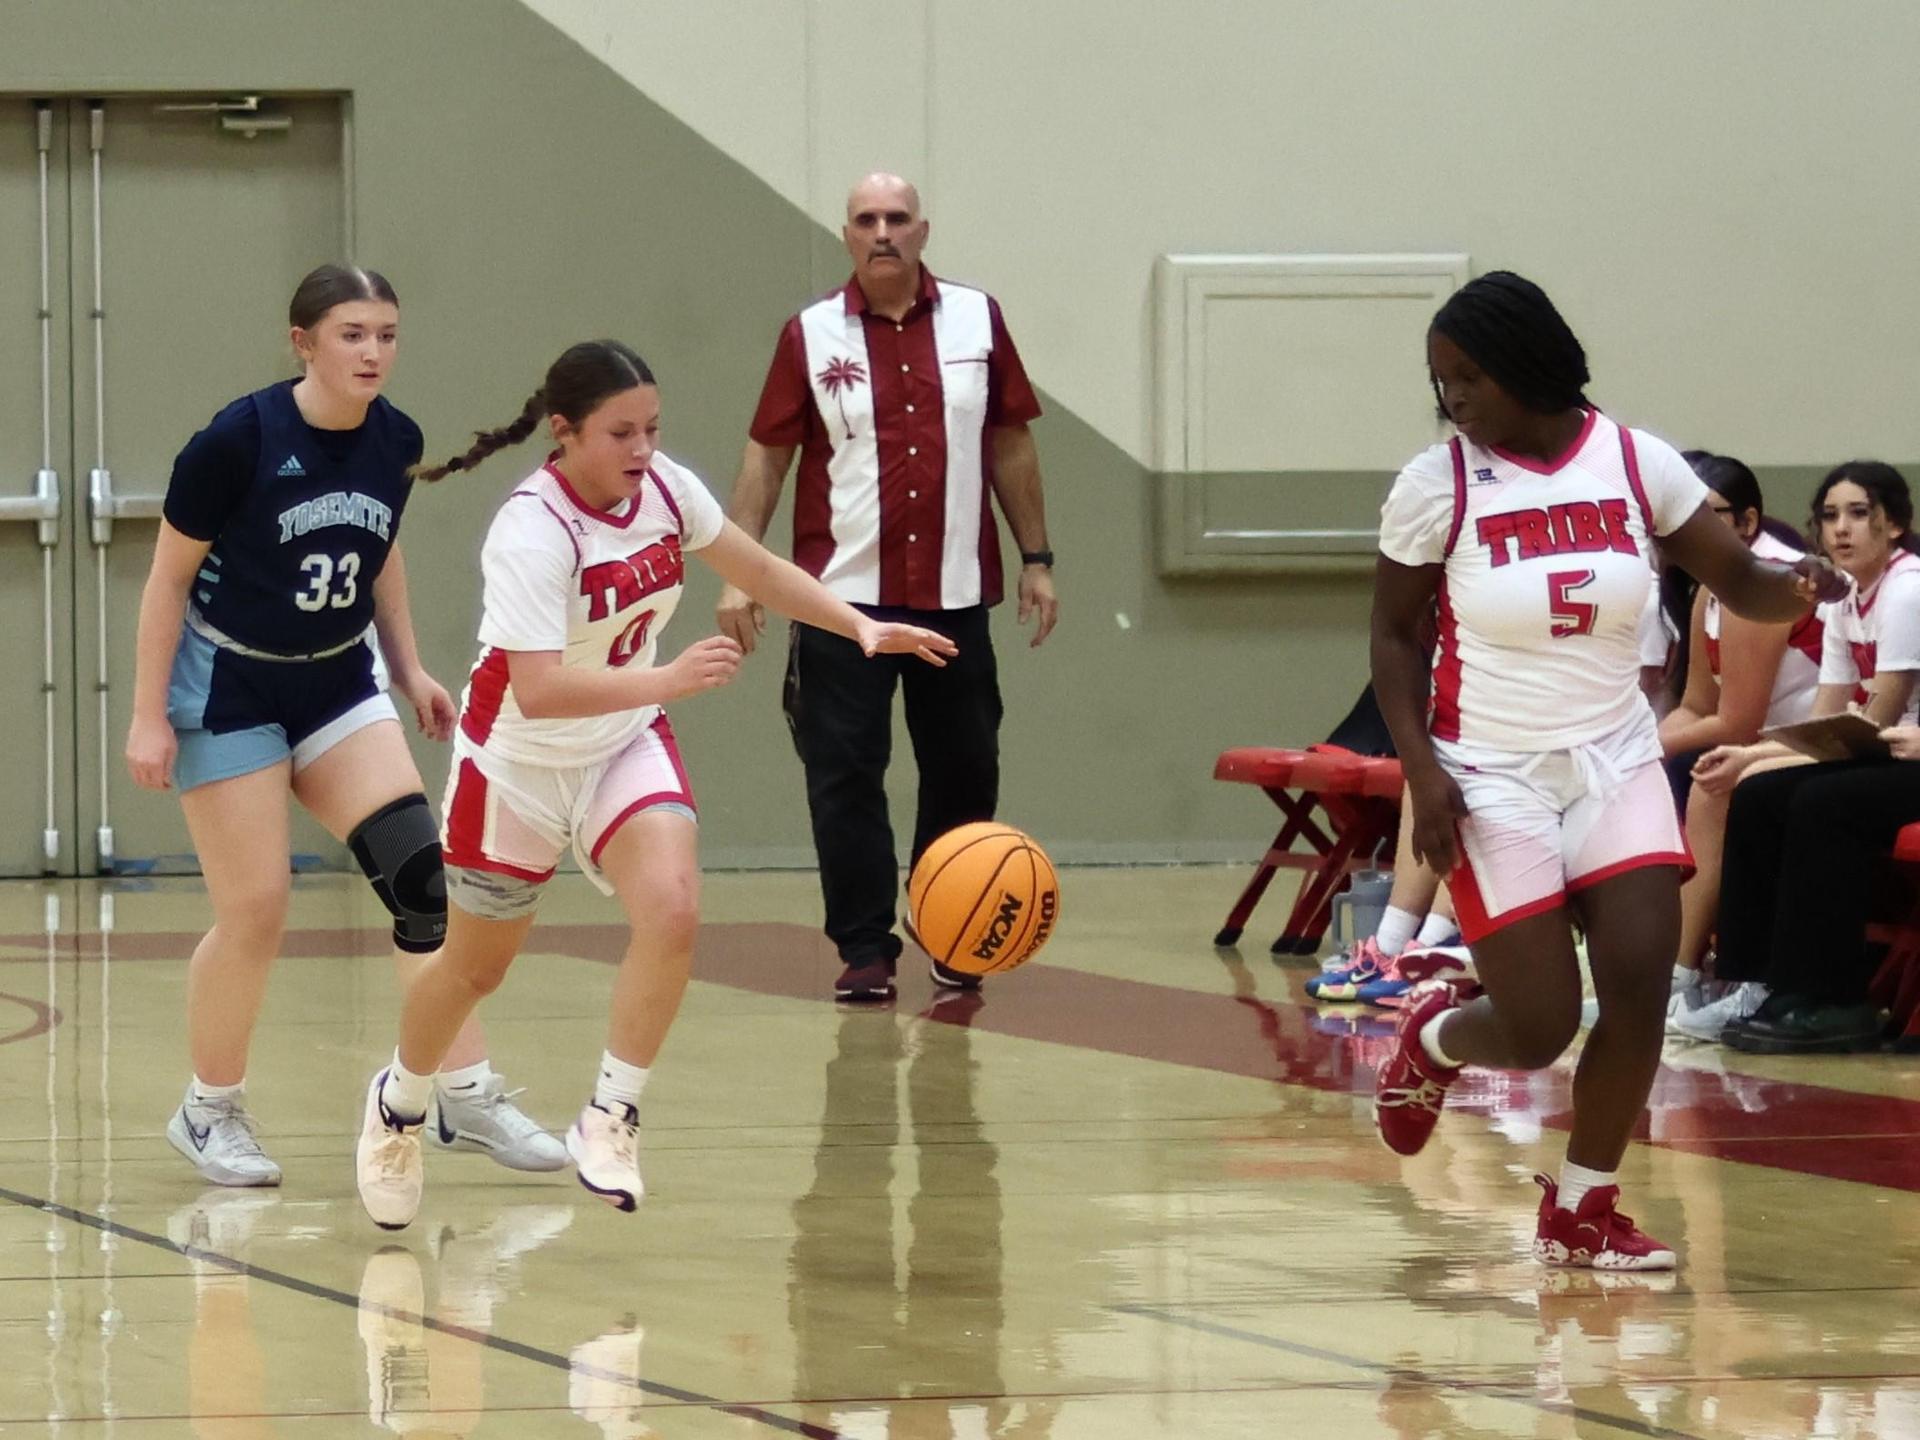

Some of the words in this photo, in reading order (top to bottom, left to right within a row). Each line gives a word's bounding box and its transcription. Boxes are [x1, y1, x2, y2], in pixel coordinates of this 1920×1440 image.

[278, 491, 392, 544] YOSEMITE
[1475, 498, 1640, 568] TRIBE
[295, 552, 361, 612] 33
[1547, 569, 1598, 637] 5
[607, 609, 657, 667] 0
[972, 892, 1023, 960] NCAA
